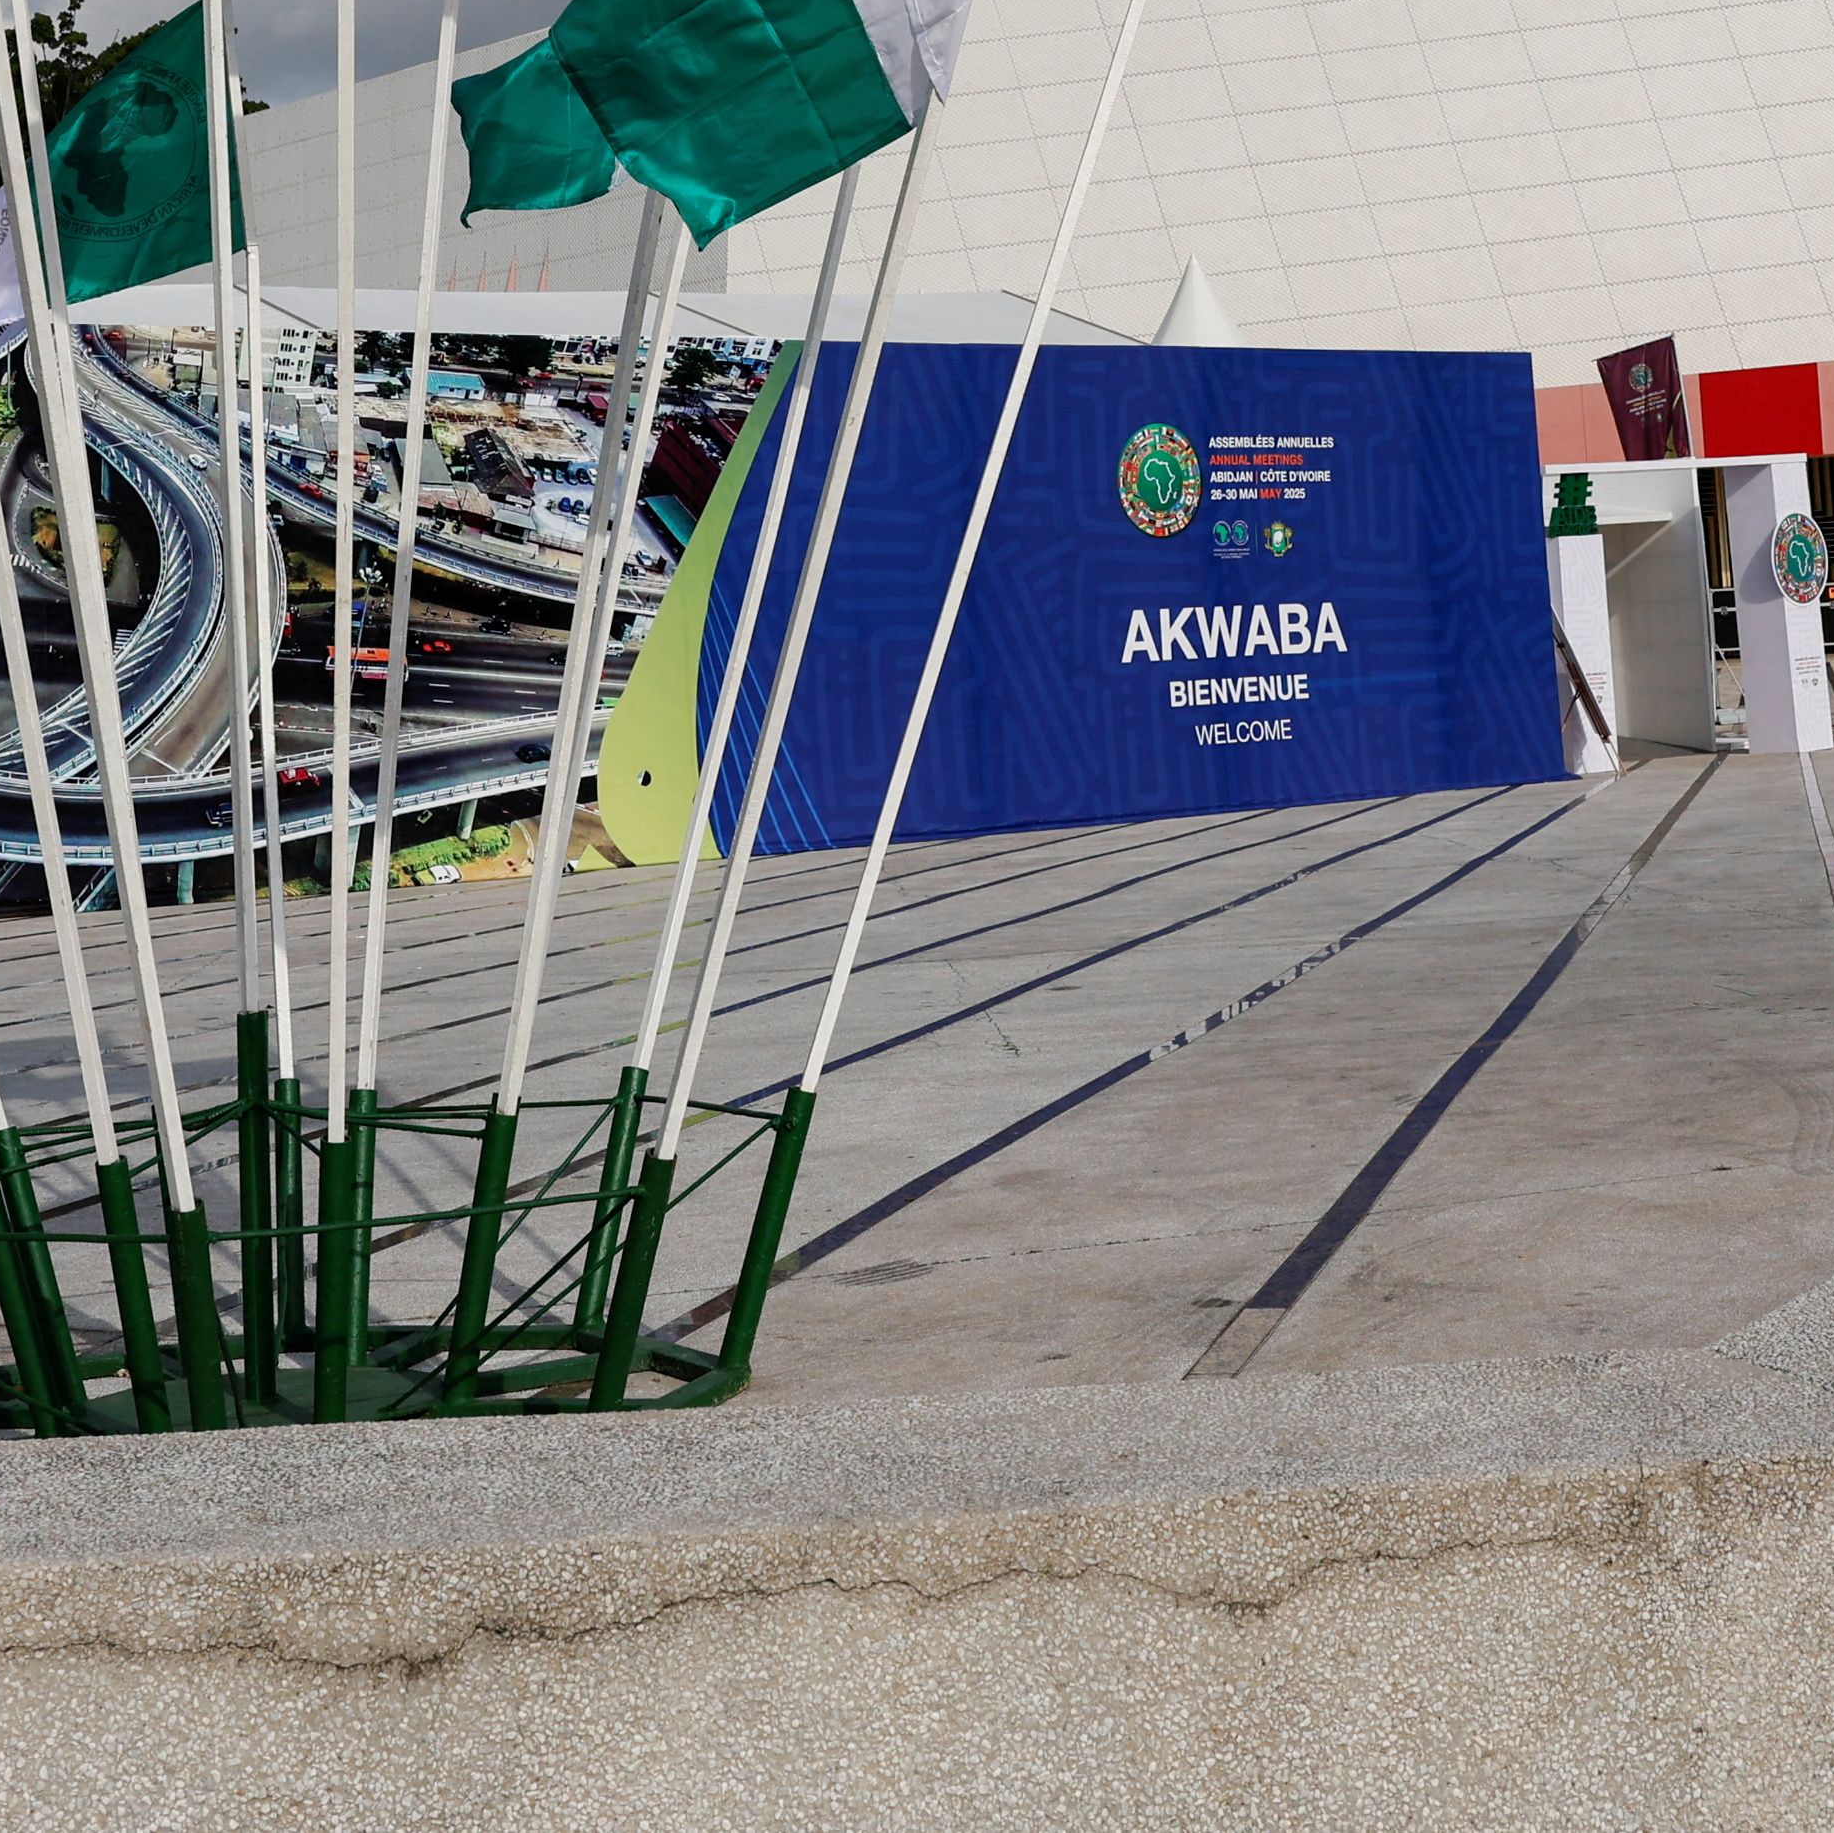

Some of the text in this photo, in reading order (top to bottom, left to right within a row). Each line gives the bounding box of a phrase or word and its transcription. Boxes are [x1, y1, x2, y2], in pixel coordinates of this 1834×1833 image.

[1209, 434, 1334, 448] ASSEMBLÉES ANNUELLES
[1209, 454, 1304, 465] ANNUAL MEETINGS
[1210, 468, 1331, 483] ABIDJAN CÔTE D'IVOIRE
[1210, 487, 1306, 500] 26-30 MAI MAY 2025
[1121, 602, 1348, 664] AKWABA
[1169, 674, 1310, 707] BIENVENUE
[1195, 719, 1293, 746] WELCOME
